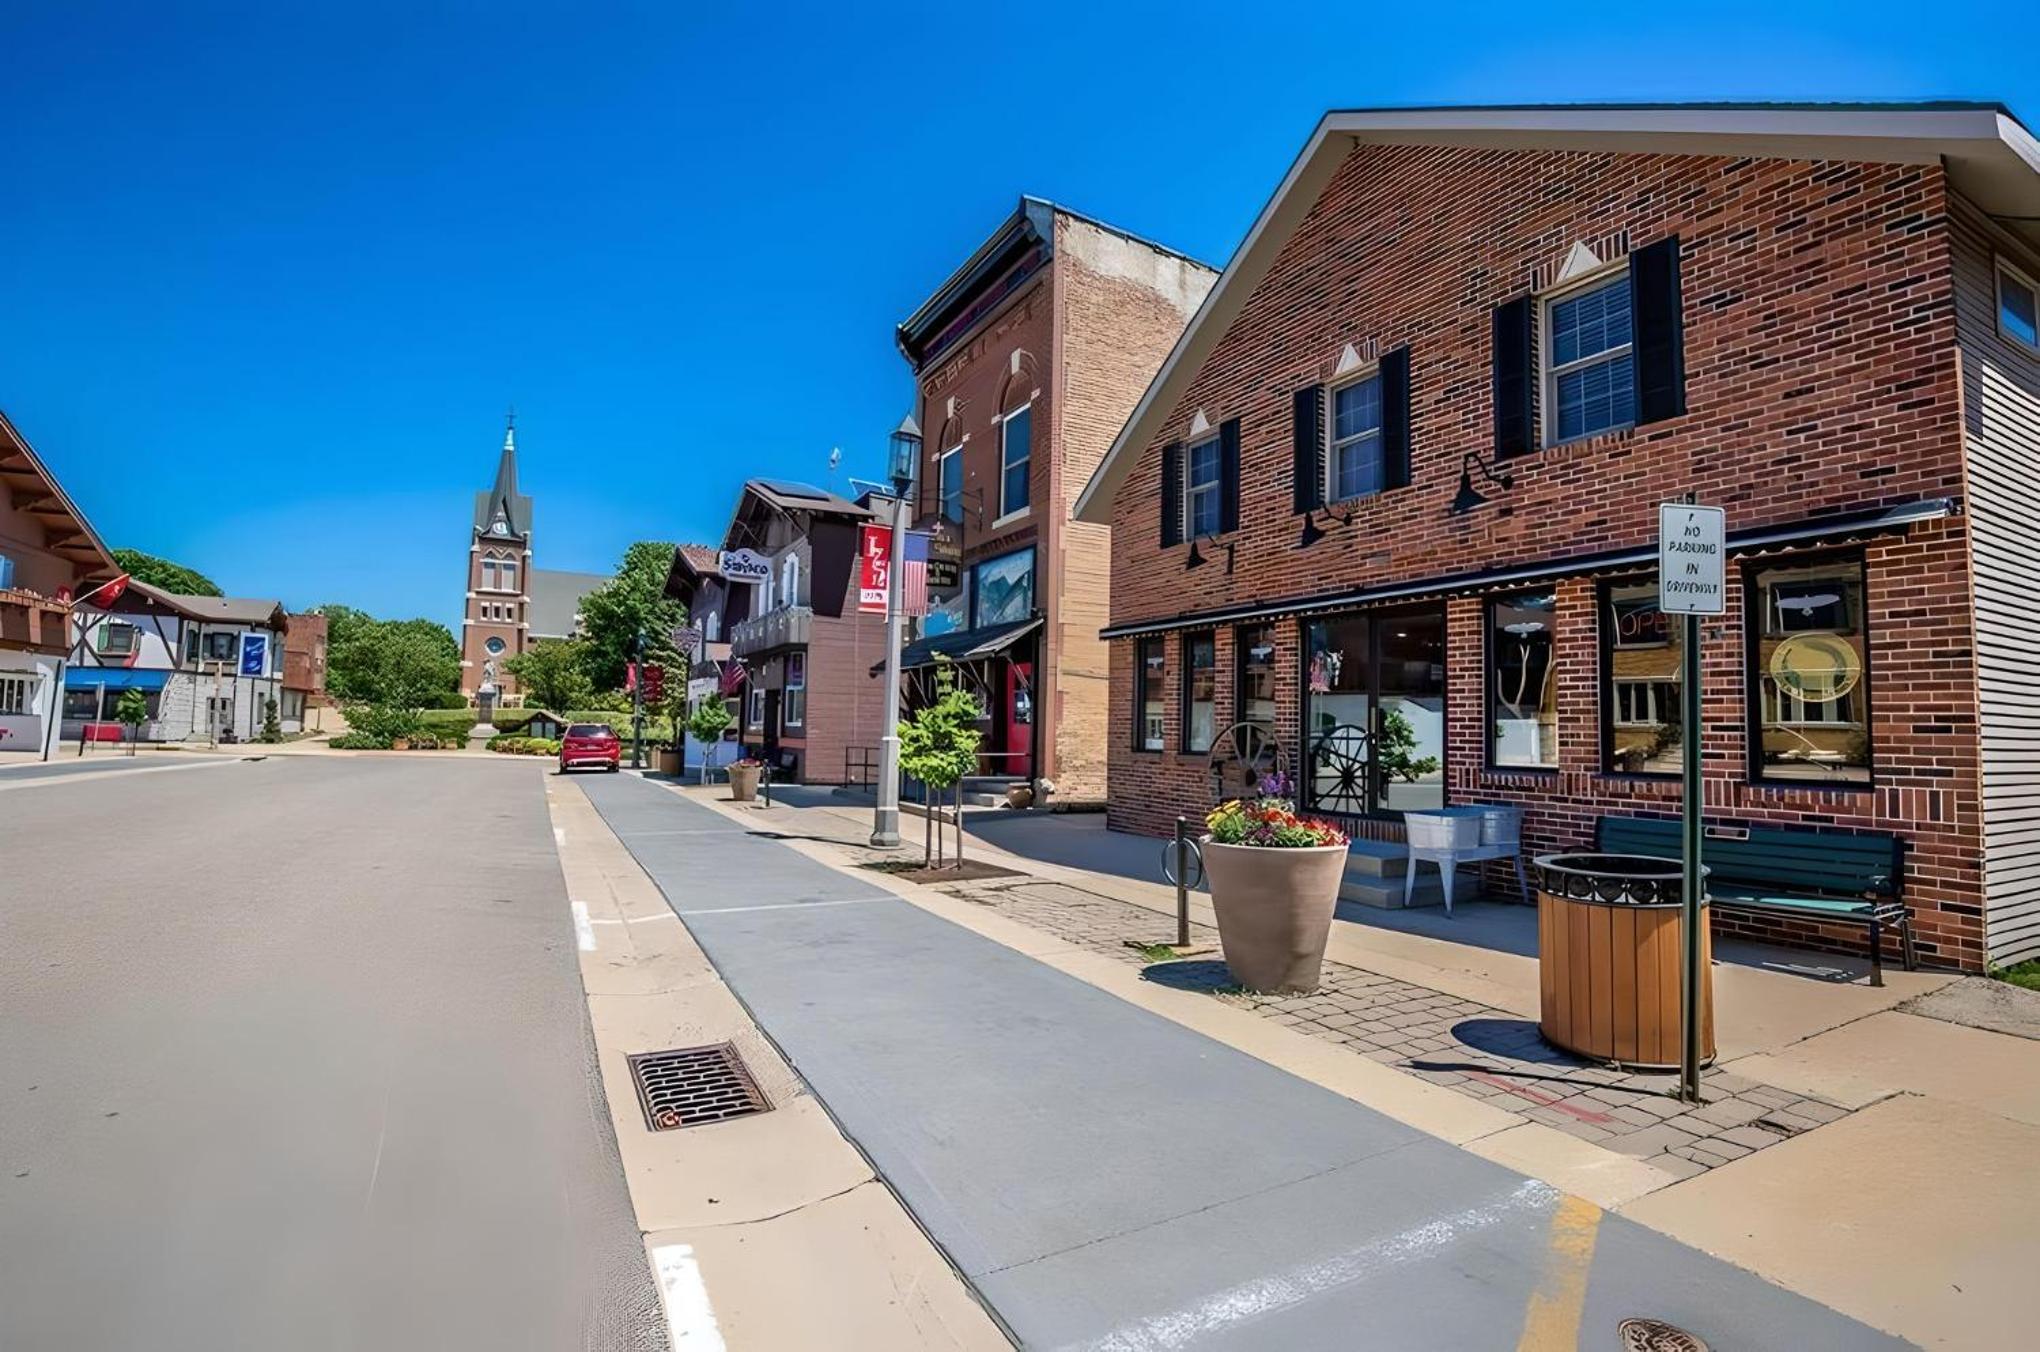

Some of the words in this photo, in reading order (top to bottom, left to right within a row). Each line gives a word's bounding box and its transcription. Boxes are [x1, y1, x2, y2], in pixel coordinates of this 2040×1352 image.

[1684, 526, 1701, 538] NO
[1685, 563, 1700, 575] IN
[1620, 611, 1680, 635] OPE
